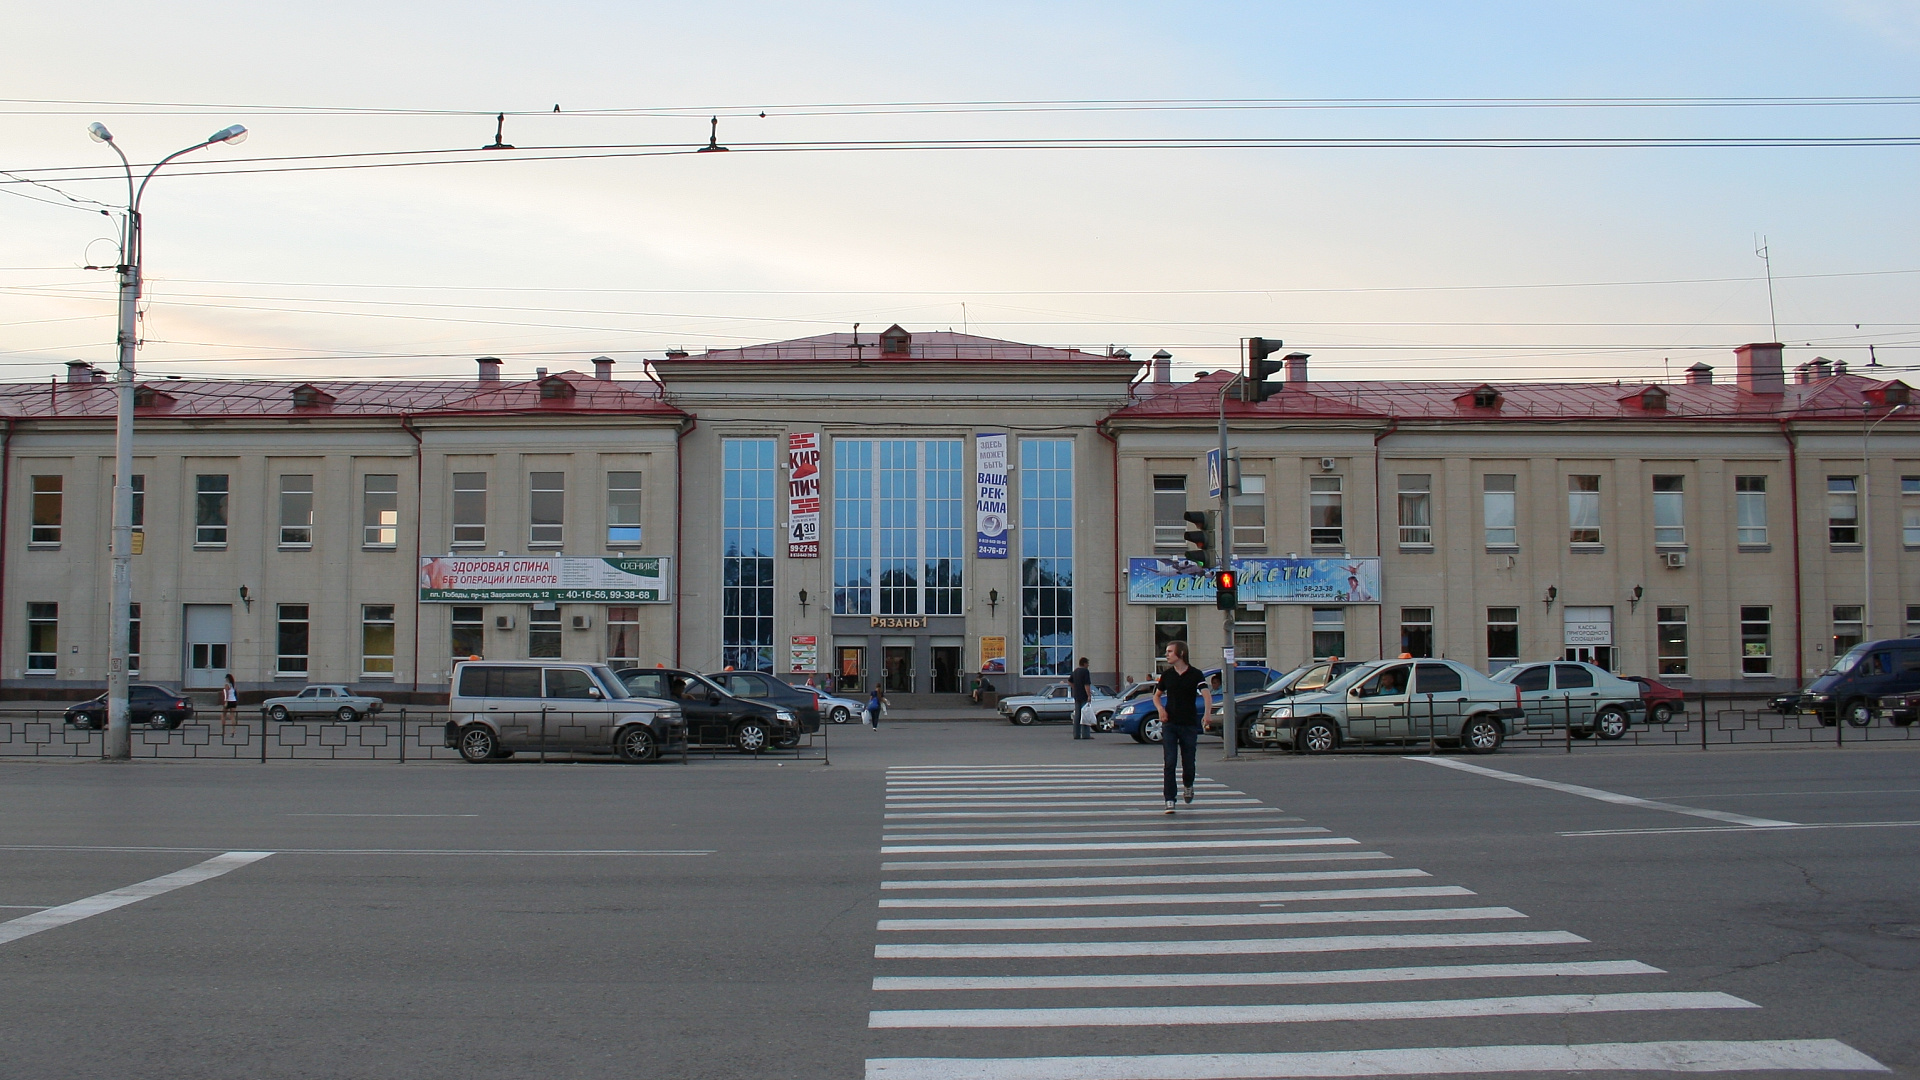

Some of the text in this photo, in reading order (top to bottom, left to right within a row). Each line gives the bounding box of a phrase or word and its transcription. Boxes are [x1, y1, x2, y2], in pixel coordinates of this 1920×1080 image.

[980, 441, 1002, 449] ЗДЕСЬ
[789, 451, 820, 469] КИР
[980, 451, 1004, 459] МОЖЕТ
[983, 461, 1003, 469] БЫТЬ
[978, 472, 1007, 486] ВАША
[789, 479, 820, 497] ПИЧ
[977, 500, 1006, 513] ЛАМА
[793, 523, 815, 540] 4 30
[452, 561, 549, 574] ЗДОРОВАЯ СПИНА
[442, 575, 458, 583] БЕЗ
[460, 575, 505, 585] ОПЕРАЦИЙ
[513, 575, 557, 584] ЛЕКАРСТВ
[566, 590, 608, 599] 40-16-56,
[610, 590, 650, 599] 99-38-68
